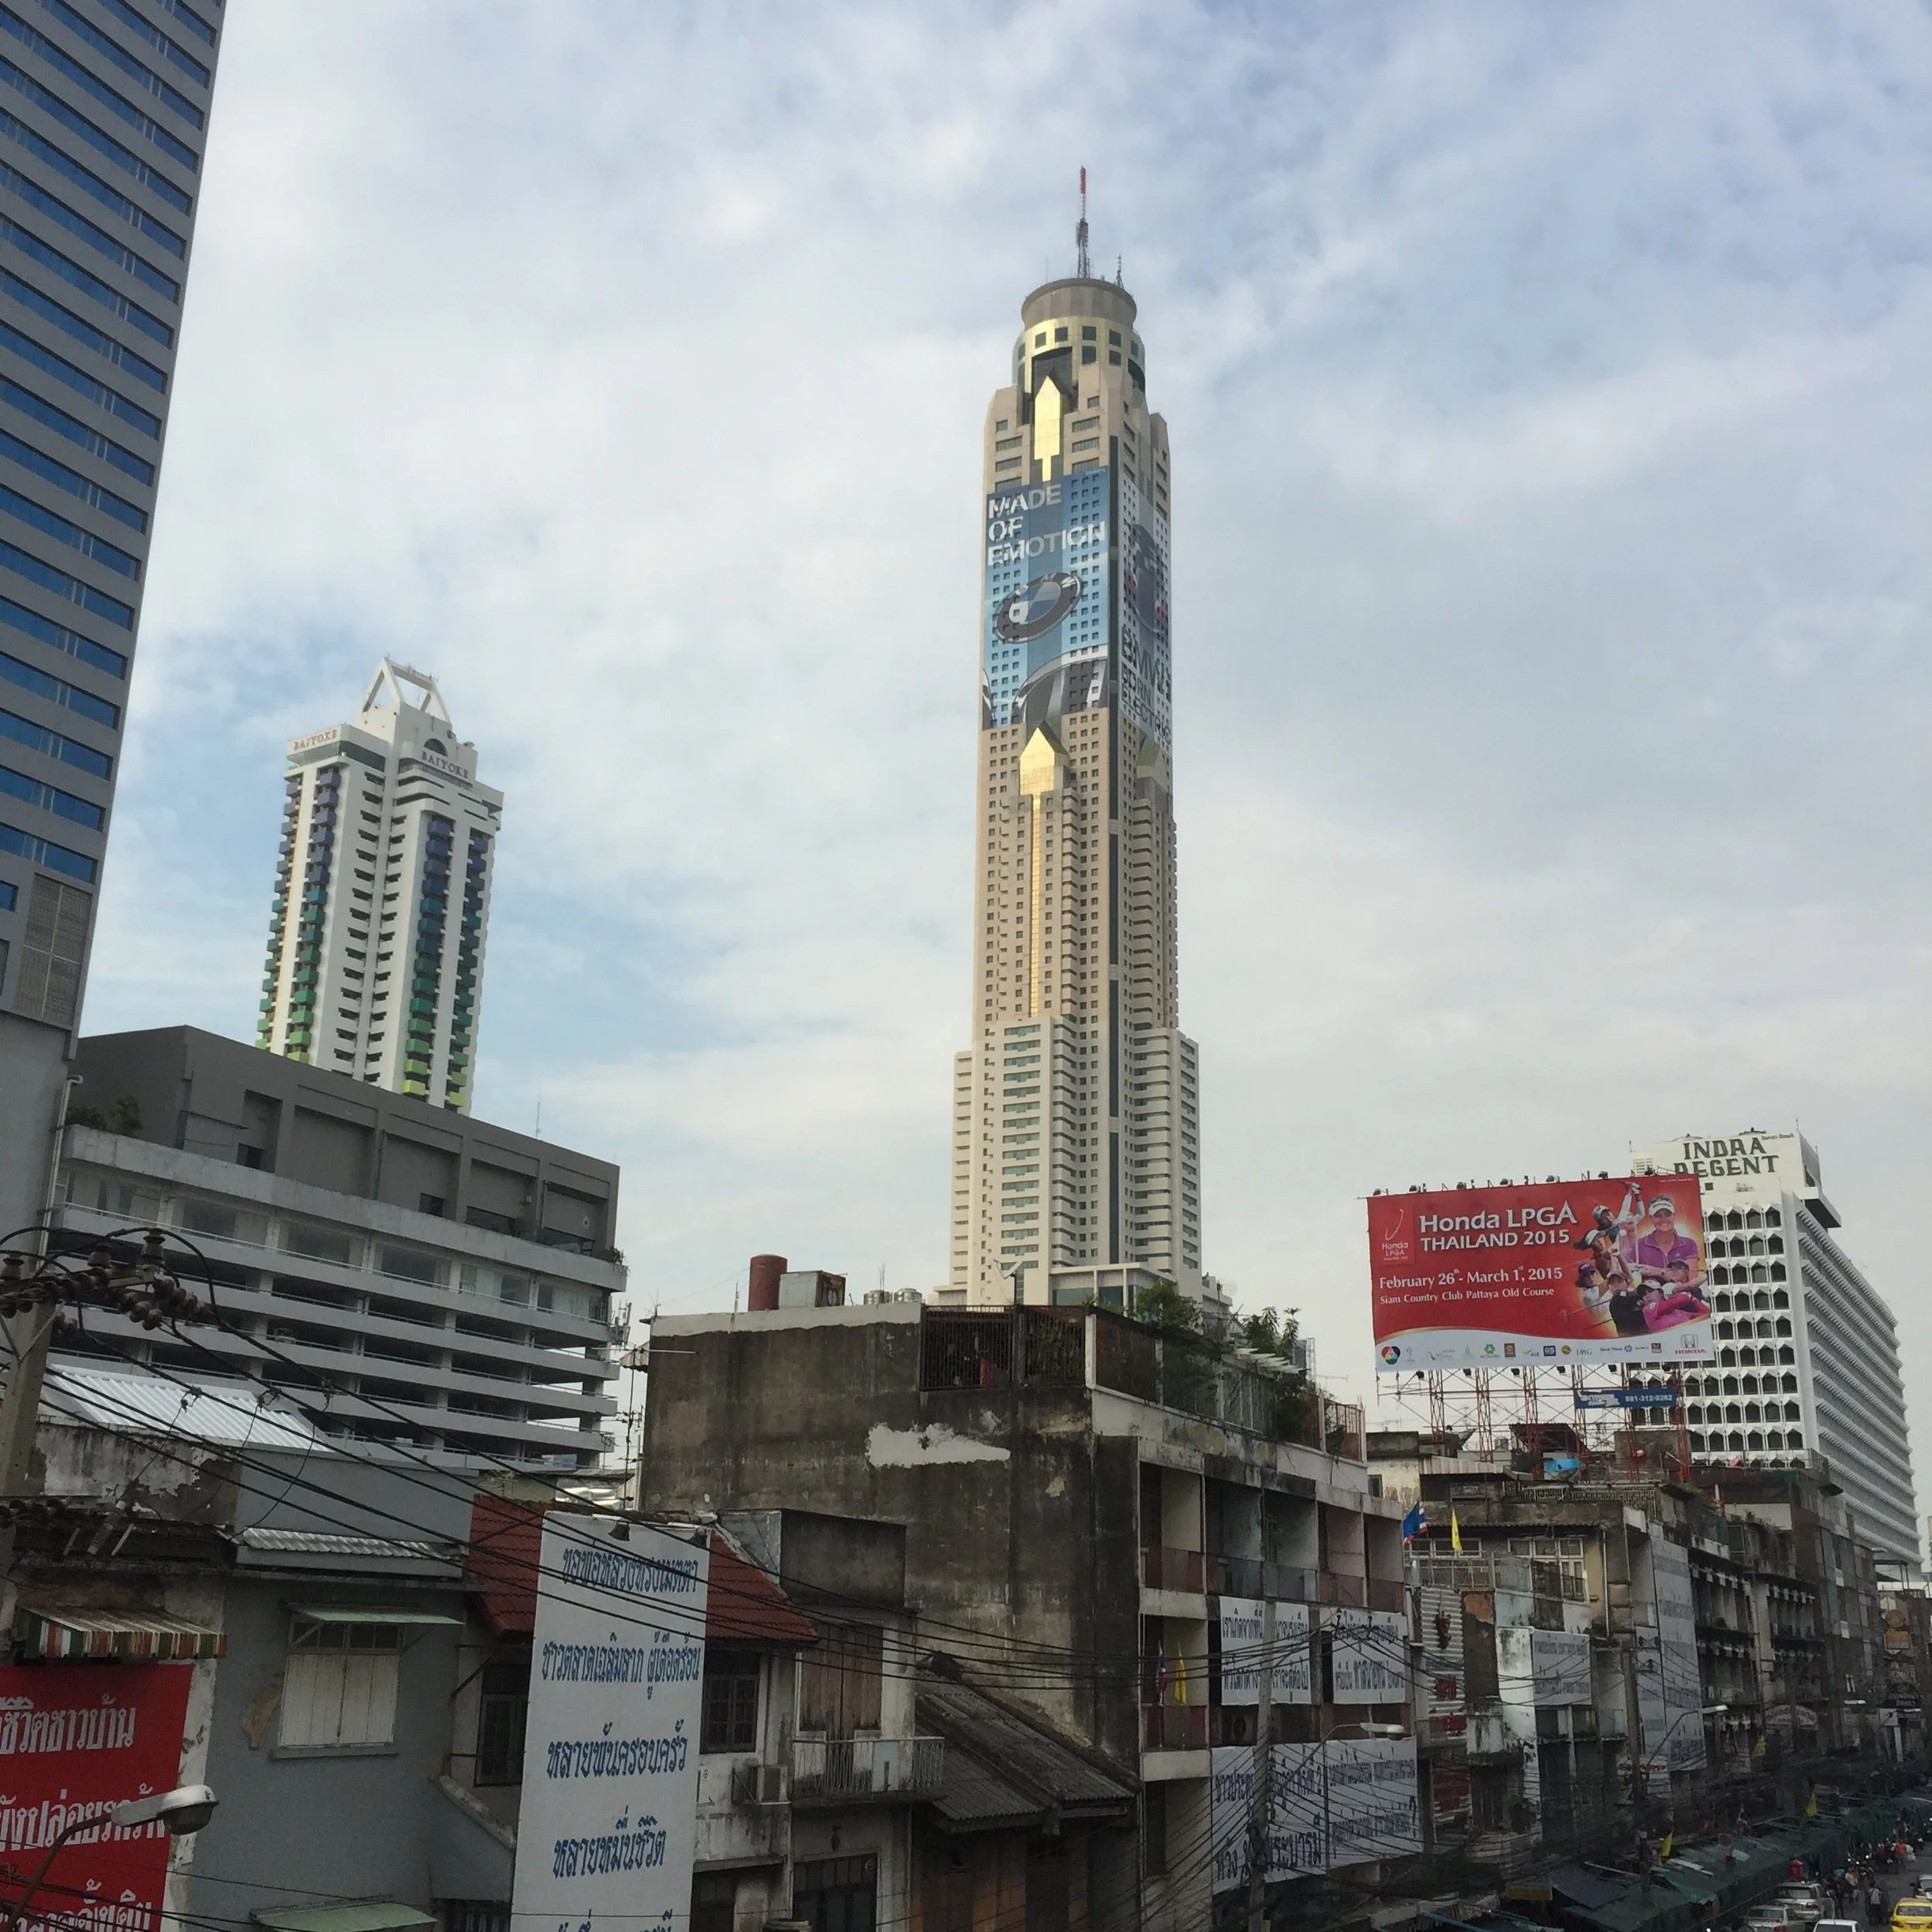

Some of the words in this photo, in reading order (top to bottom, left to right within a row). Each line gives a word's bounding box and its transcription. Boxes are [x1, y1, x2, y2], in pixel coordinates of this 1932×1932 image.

[988, 484, 1062, 519] MADE
[988, 515, 1024, 543] OF
[987, 521, 1106, 567] EMOTION
[294, 728, 338, 751] BAIYOKE
[421, 750, 470, 779] BAIYOKE
[1683, 1136, 1767, 1160] INDRA
[1419, 1209, 1500, 1233] Honda
[1505, 1200, 1578, 1228] LPGA
[1381, 1241, 1409, 1250] Honda
[1420, 1231, 1519, 1252] THAILAND
[1522, 1228, 1571, 1246] 2015
[1379, 1275, 1436, 1290] February
[1466, 1268, 1509, 1284] March
[1528, 1267, 1563, 1281] 2015
[1380, 1294, 1402, 1305] Siam
[1403, 1293, 1439, 1305] Country
[1441, 1290, 1463, 1301] Club
[1466, 1289, 1500, 1301] Pattaya
[1502, 1287, 1520, 1297] Old
[1522, 1286, 1555, 1297] Course
[546, 1719, 688, 1779] หลายพันครอบครัว
[552, 1805, 667, 1878] หลายหมื่นชีวิต
